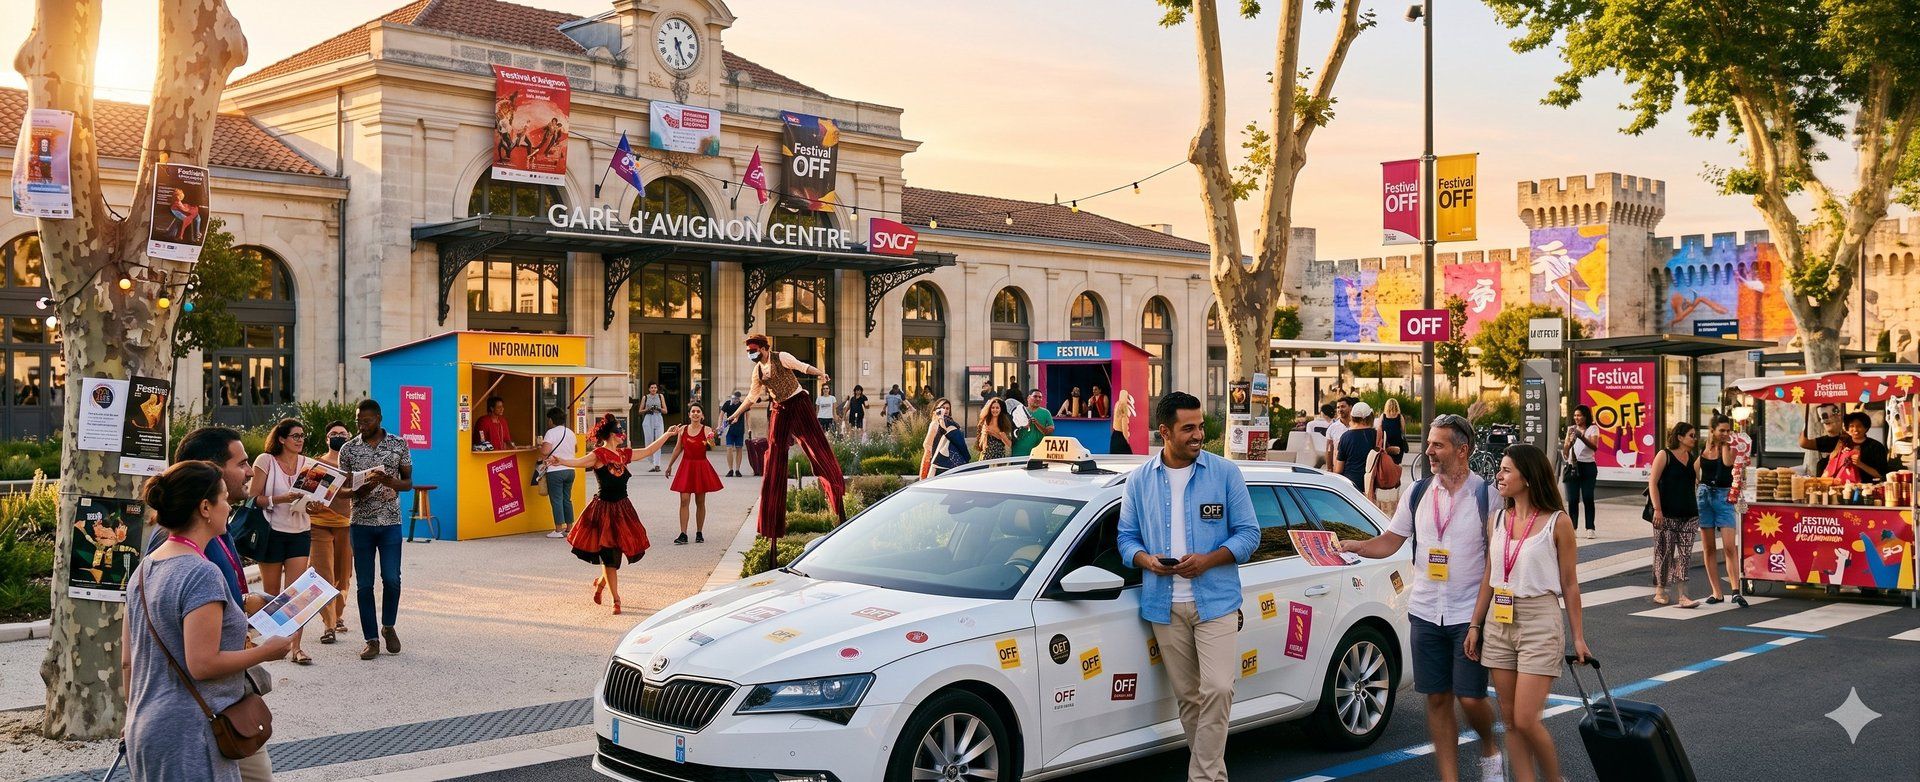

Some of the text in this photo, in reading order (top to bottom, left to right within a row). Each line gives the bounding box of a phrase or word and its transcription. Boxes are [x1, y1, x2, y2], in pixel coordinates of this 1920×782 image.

[500, 70, 531, 83] Festival
[794, 142, 831, 159] Festival
[792, 155, 831, 179] OFF
[1385, 179, 1418, 194] Festival
[1438, 174, 1473, 190] Festival
[1385, 192, 1418, 213] OFF
[1438, 188, 1473, 209] OFF
[547, 203, 852, 250] GARE d'AVIGNON CENTRE
[872, 232, 916, 250] SNCF
[1407, 317, 1443, 335] OFF
[489, 342, 559, 358] INFORMATION
[1056, 346, 1100, 357] FESTIVAL
[1589, 367, 1644, 385] Festival
[1816, 382, 1847, 391] Festival
[1595, 402, 1646, 428] OFF
[1045, 439, 1069, 452] TAXI
[1203, 505, 1222, 515] OFF
[1802, 516, 1841, 526] FESTIVAL
[1261, 599, 1275, 612] OFF
[999, 646, 1018, 660] OFF
[1082, 654, 1099, 671] OFF
[1242, 656, 1257, 670] OFF
[1114, 678, 1136, 692] OFF
[1055, 689, 1076, 703] OFF
